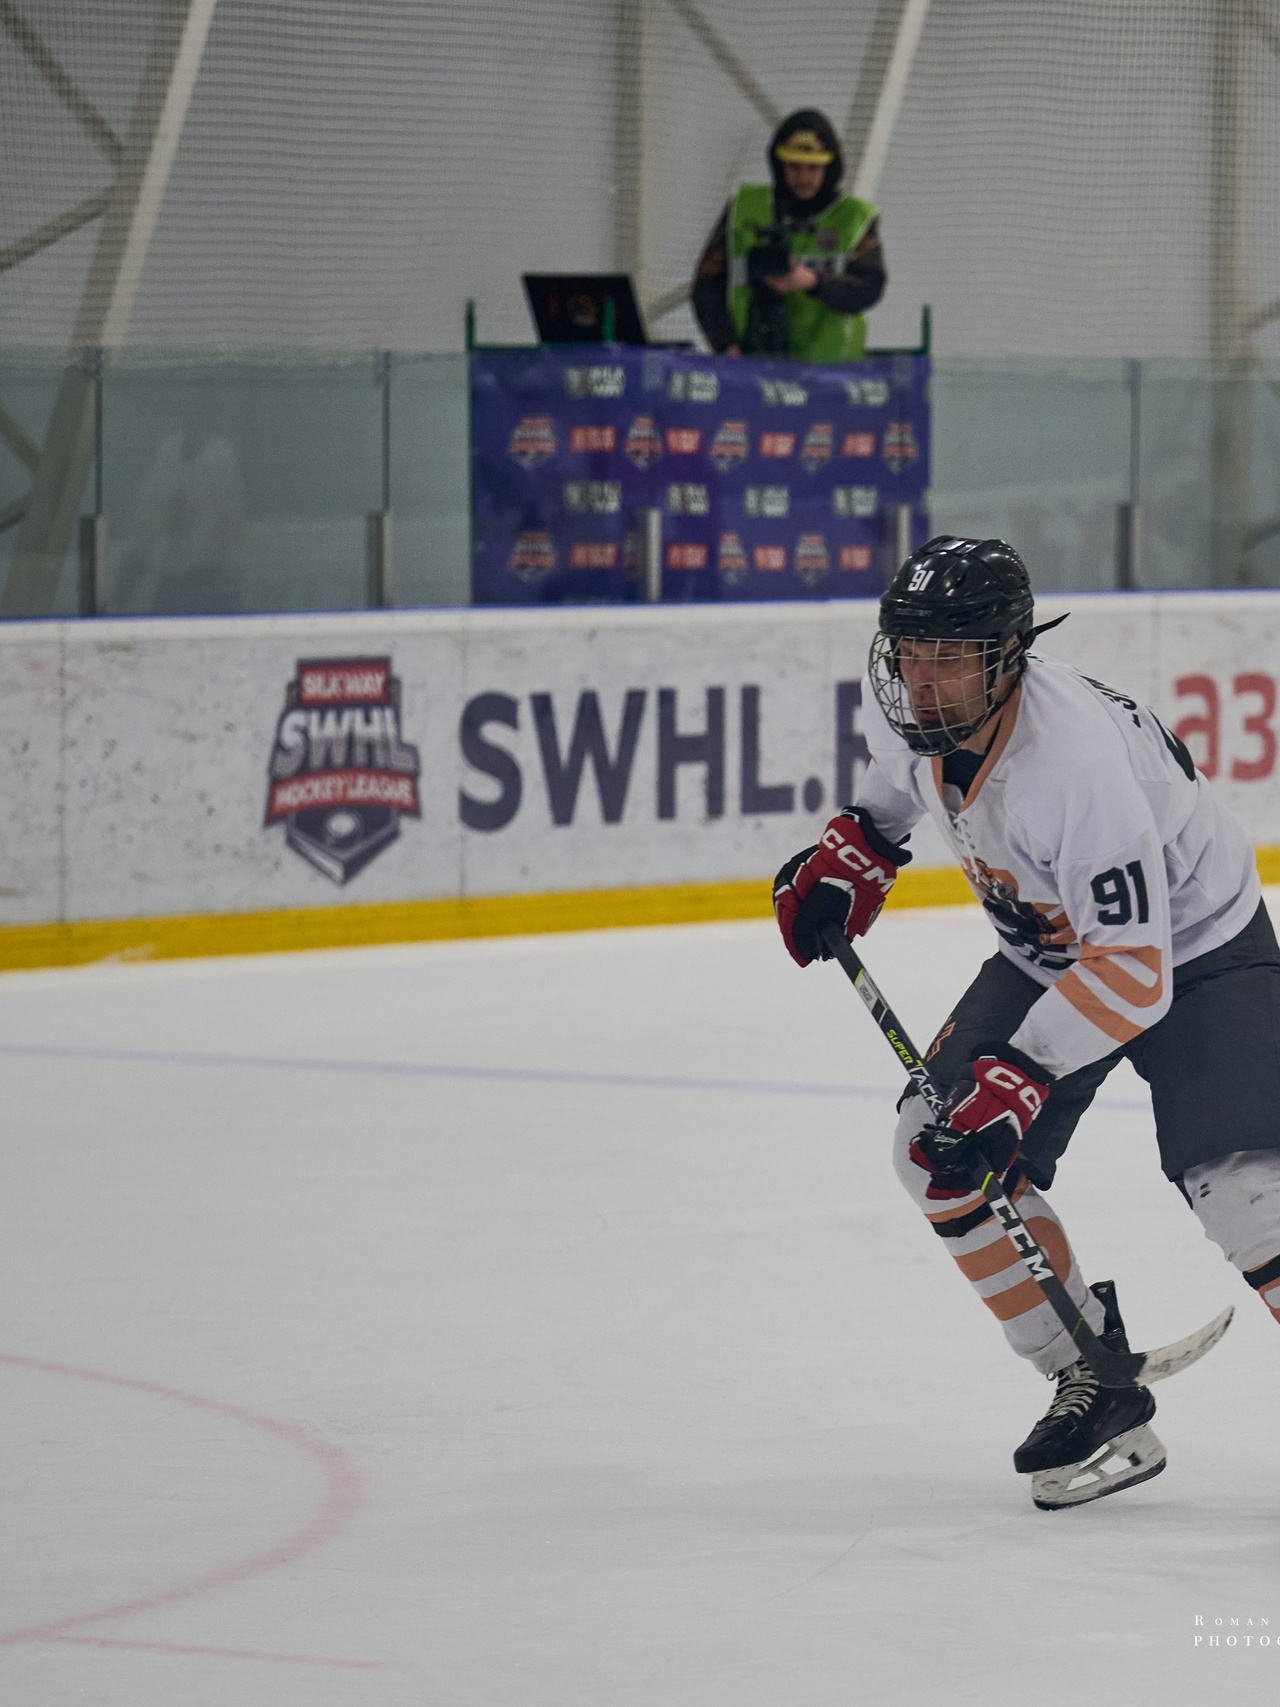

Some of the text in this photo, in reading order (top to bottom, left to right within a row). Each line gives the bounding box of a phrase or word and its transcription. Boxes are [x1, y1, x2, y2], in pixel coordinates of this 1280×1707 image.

[907, 569, 935, 591] 91
[274, 707, 415, 777] SWHL
[821, 827, 897, 893] CCM
[1090, 860, 1150, 926] 91
[886, 1029, 914, 1065] SUPER
[989, 1194, 1055, 1282] CCM
